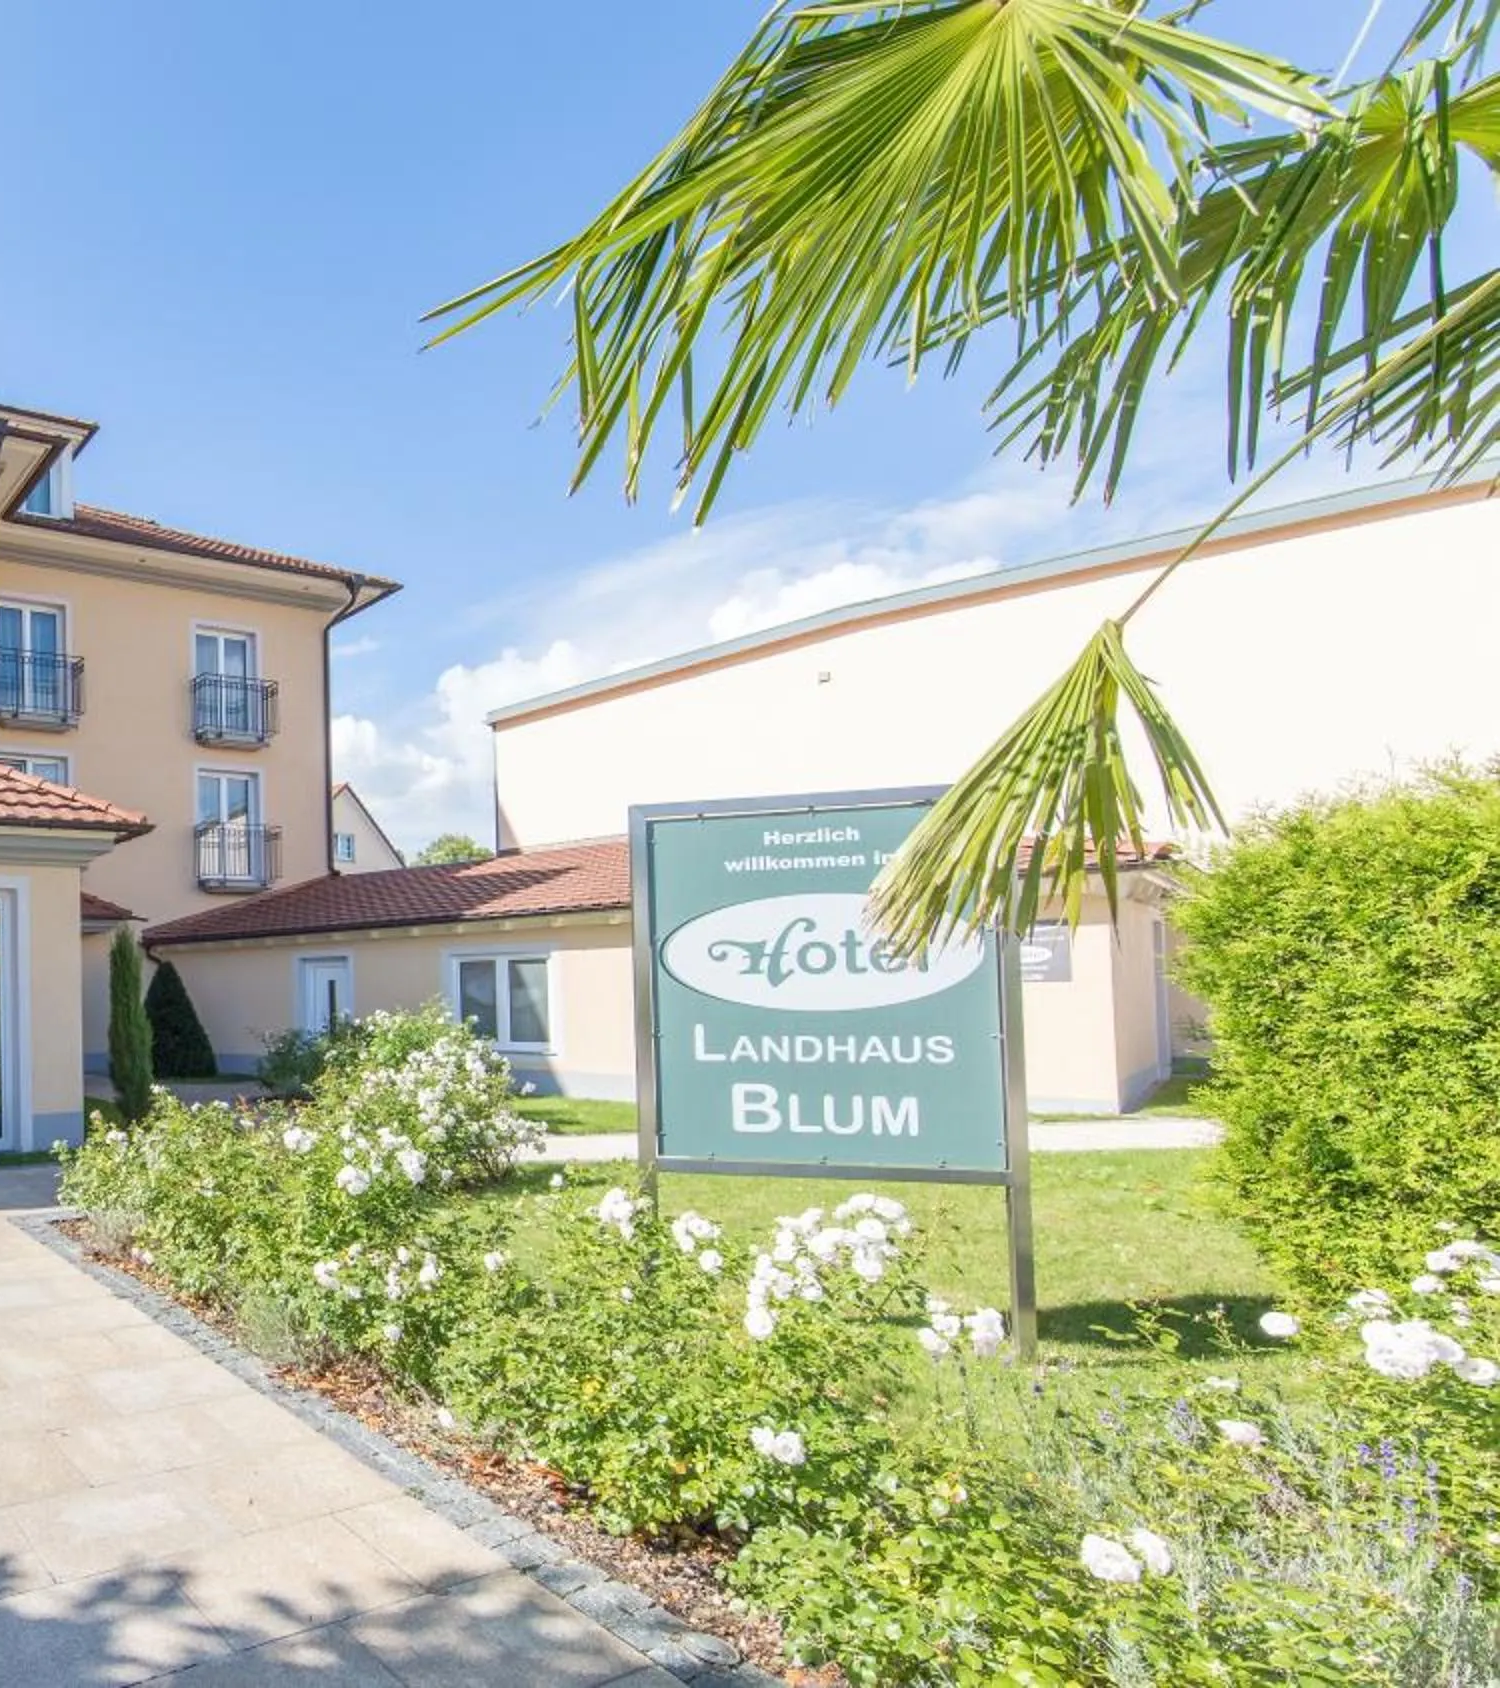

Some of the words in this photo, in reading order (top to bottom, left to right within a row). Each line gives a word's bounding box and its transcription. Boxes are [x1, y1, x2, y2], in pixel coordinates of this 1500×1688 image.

[763, 826, 861, 846] Herzlich
[724, 853, 866, 873] willkommen
[694, 1022, 956, 1065] LANDHAUS
[731, 1082, 920, 1138] BLUM
